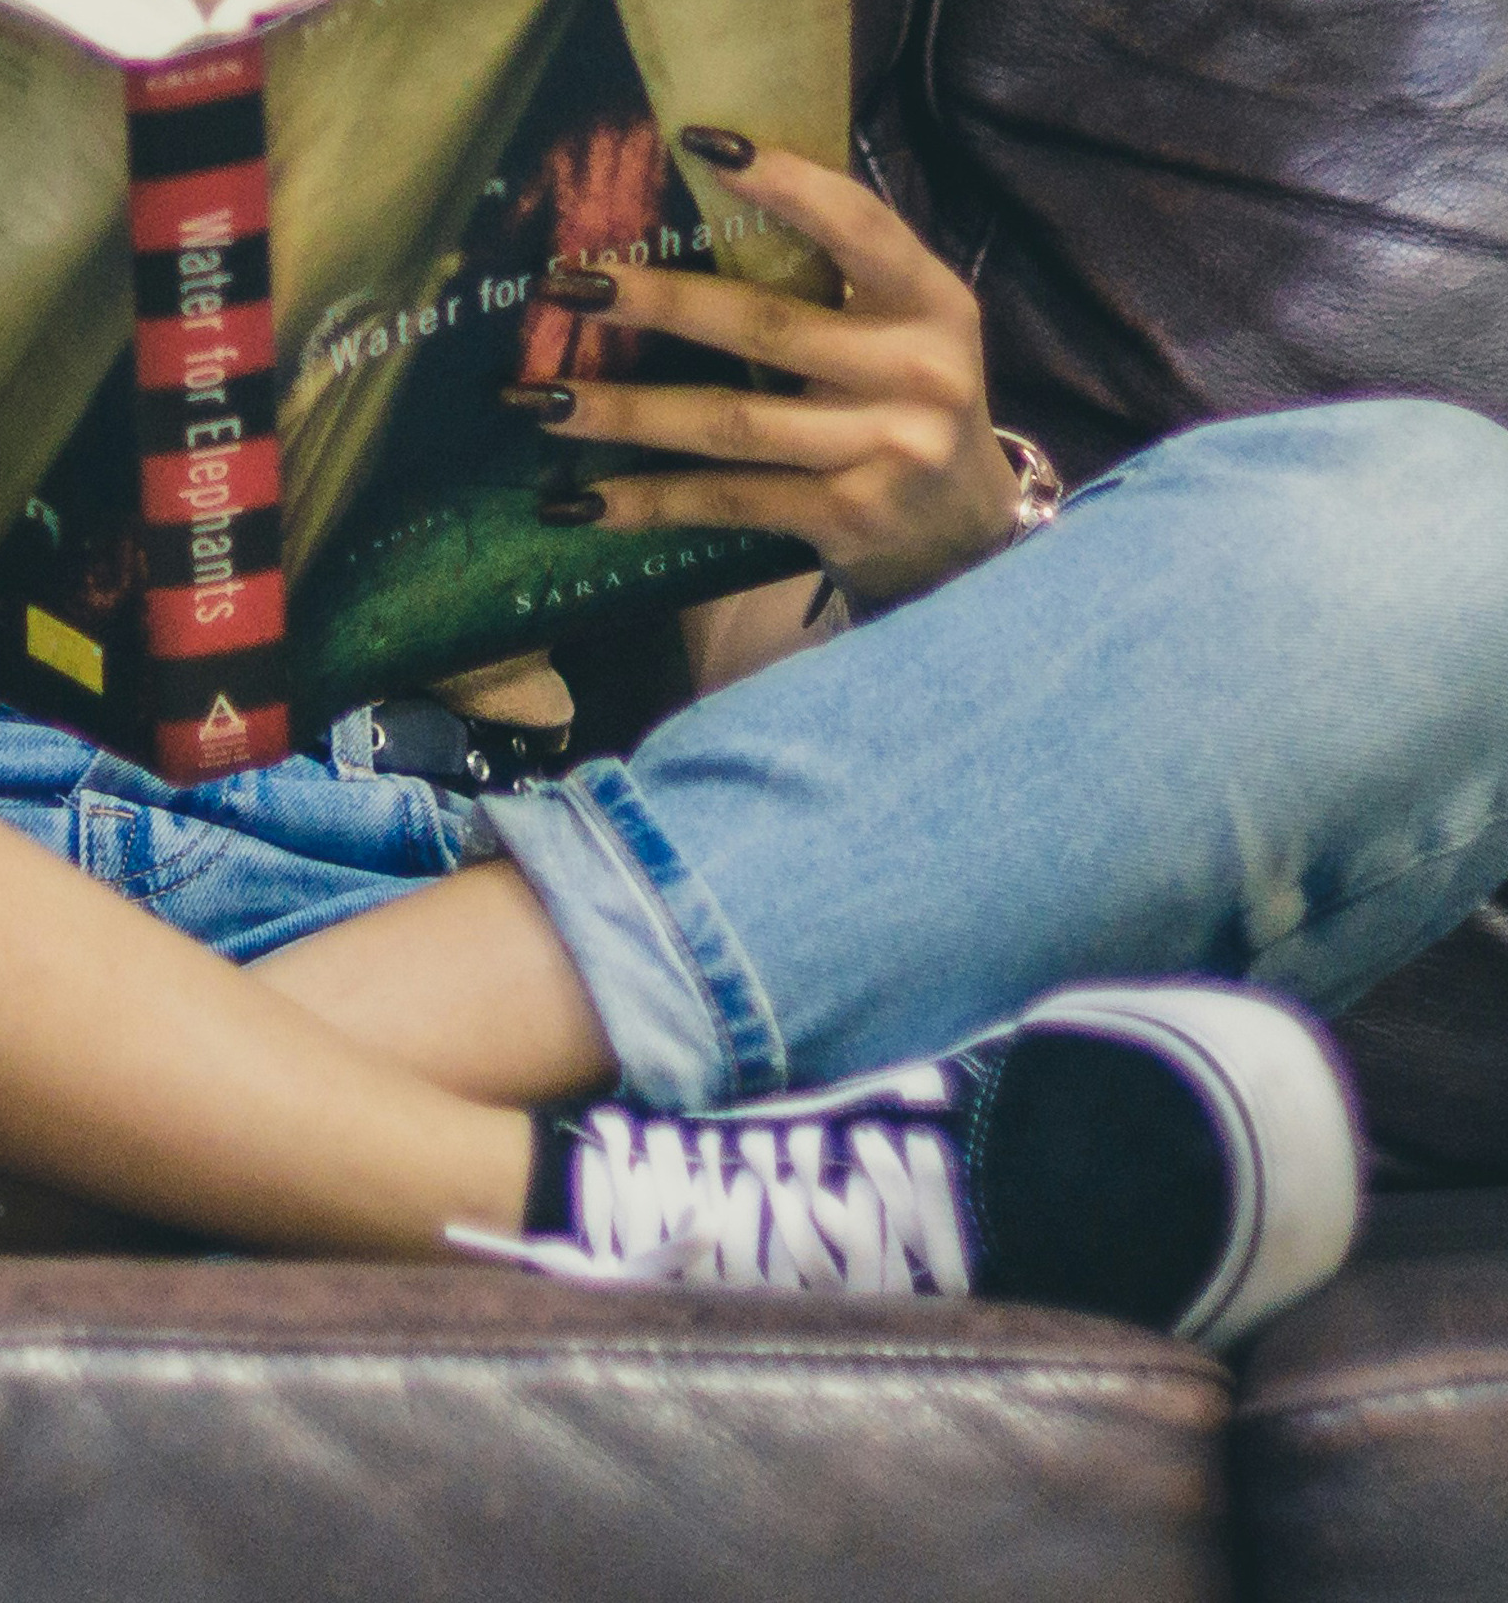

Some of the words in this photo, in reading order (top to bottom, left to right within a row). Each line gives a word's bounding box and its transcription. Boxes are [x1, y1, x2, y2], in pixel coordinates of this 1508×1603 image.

[177, 208, 233, 332] Water
[328, 294, 463, 375] Water
[478, 272, 532, 313] for
[547, 208, 789, 274] Elephant
[184, 345, 240, 404] for
[179, 416, 245, 625] Elephants
[514, 571, 623, 615] SARA
[641, 535, 756, 577] GRUE
